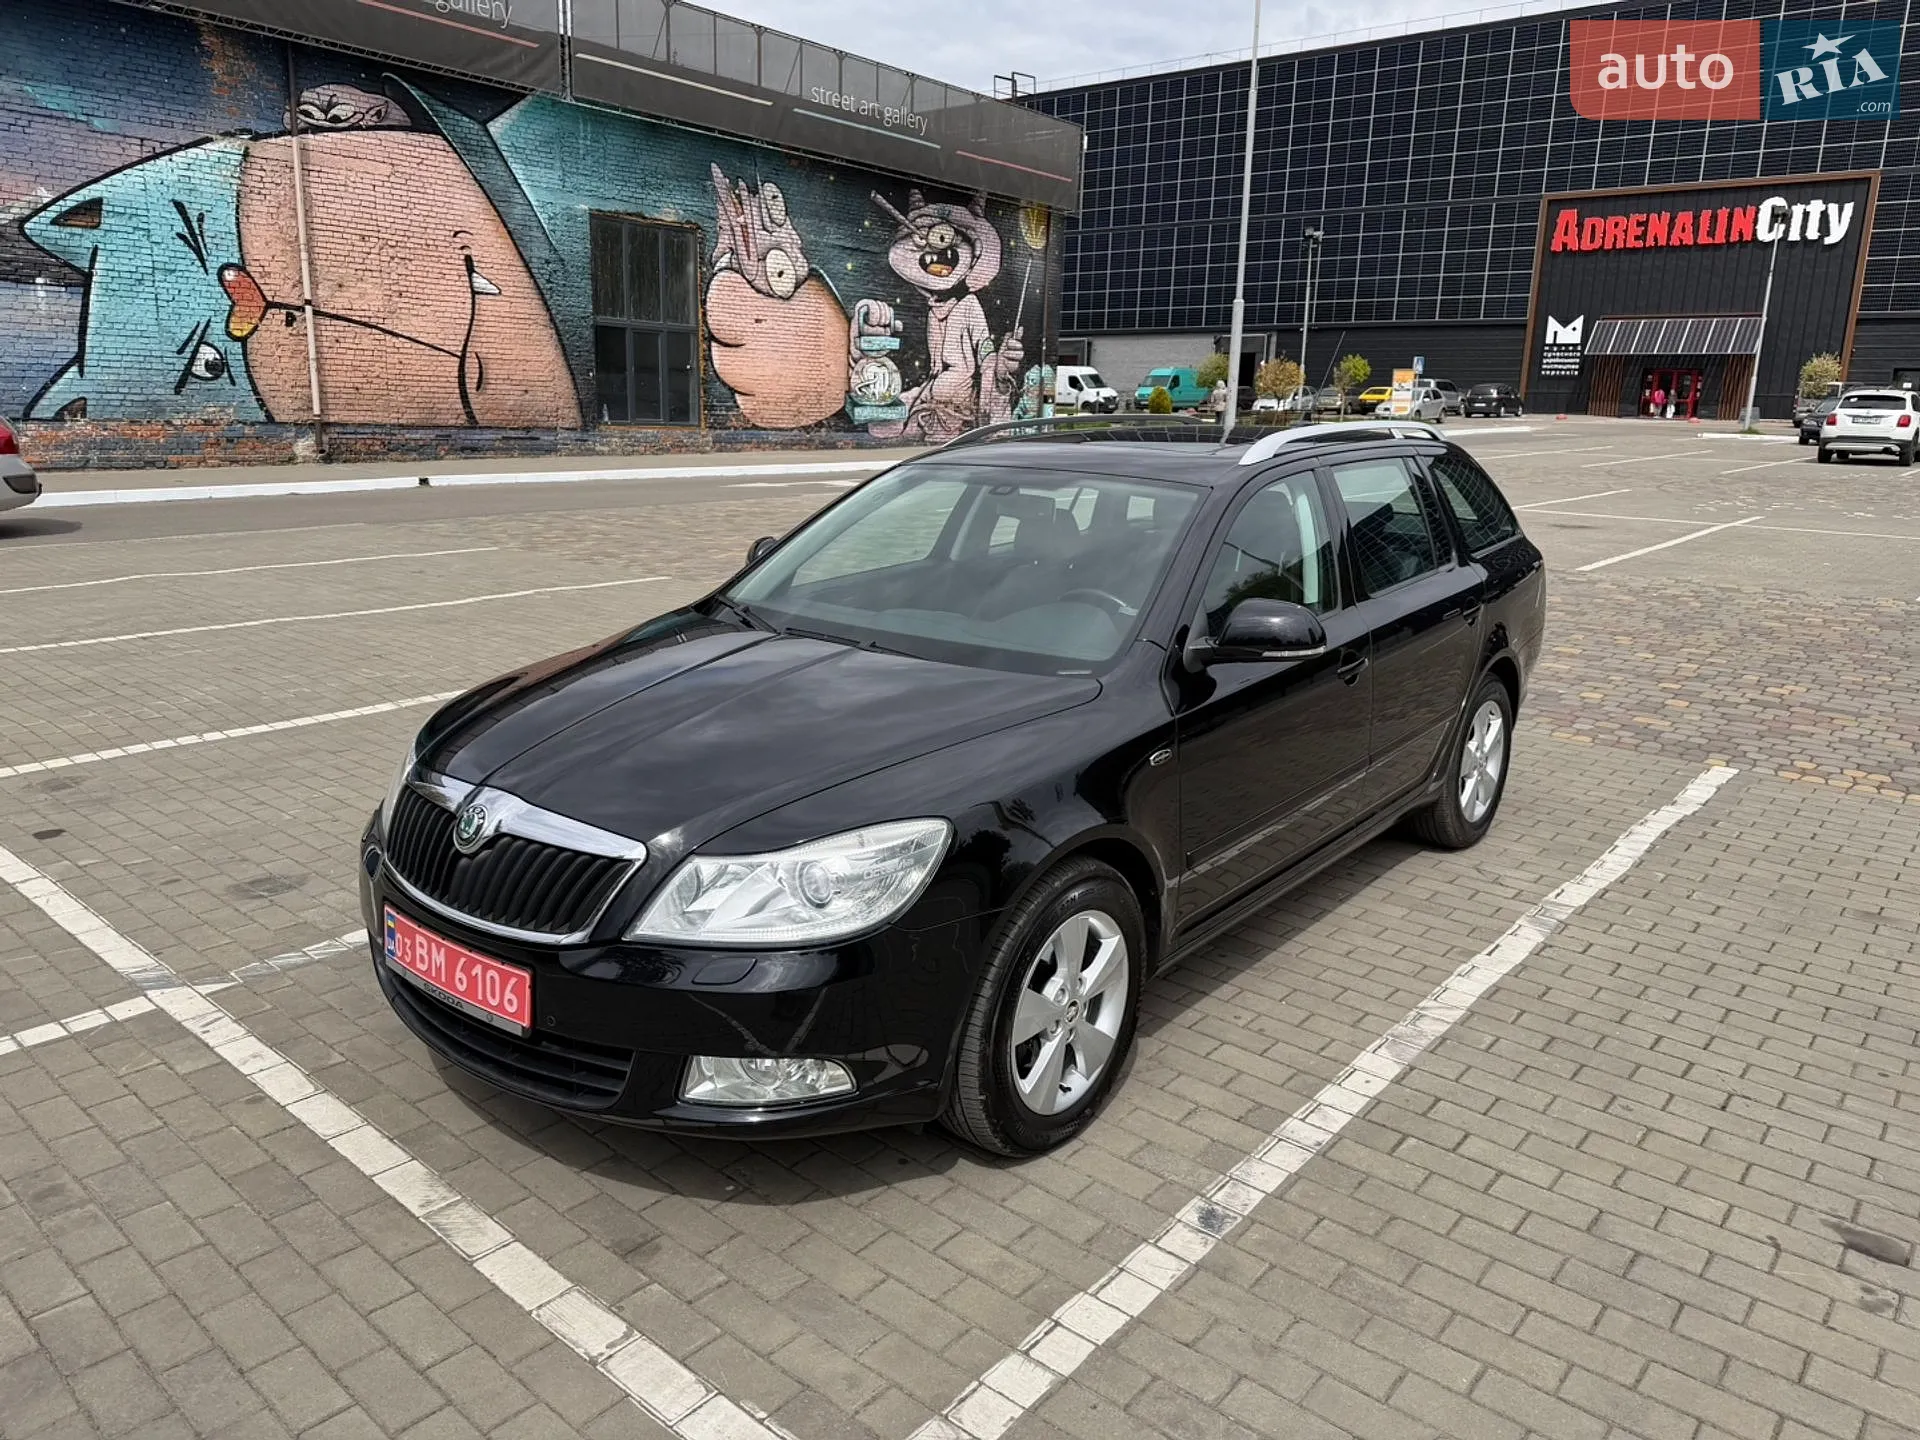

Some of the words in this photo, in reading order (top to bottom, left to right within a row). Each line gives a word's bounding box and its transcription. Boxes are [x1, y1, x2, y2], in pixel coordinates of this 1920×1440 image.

[810, 86, 855, 112] street
[859, 99, 881, 119] art
[883, 106, 928, 136] gallery
[415, 934, 447, 983] BM
[455, 957, 519, 1013] 6106
